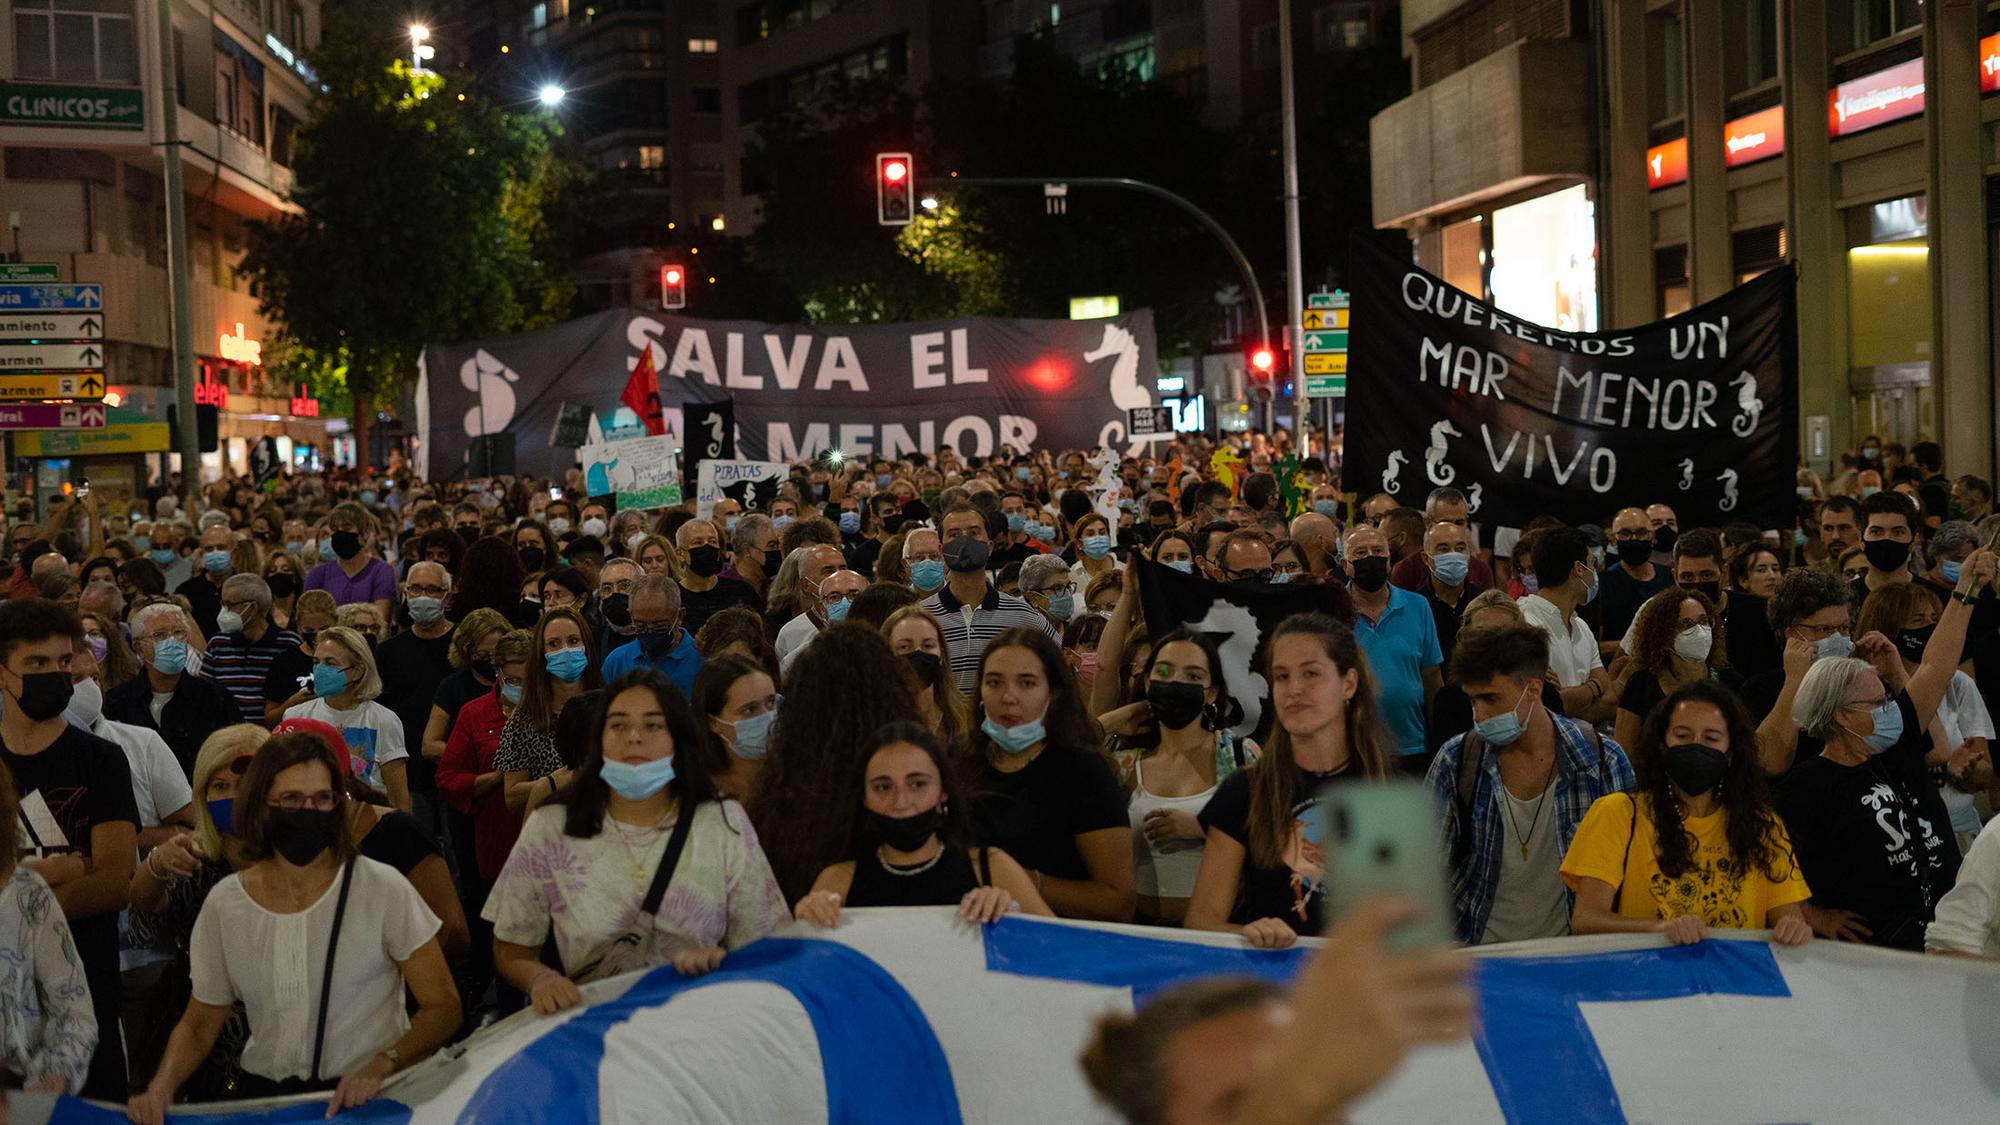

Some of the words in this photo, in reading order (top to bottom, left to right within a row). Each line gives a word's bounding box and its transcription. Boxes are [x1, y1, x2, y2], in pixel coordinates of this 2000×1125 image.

[7, 95, 110, 118] CLINICOS
[1402, 272, 1635, 357] QUEREMOS
[1670, 316, 1729, 360] UN
[627, 316, 869, 391] SALVA
[911, 328, 989, 389] EL
[1420, 337, 1509, 400] MAR
[1552, 366, 1718, 431] MENOR
[767, 415, 1038, 464] MENOR
[1481, 424, 1616, 493] VIVO
[700, 487, 714, 502] del
[714, 464, 762, 480] PIRATAS
